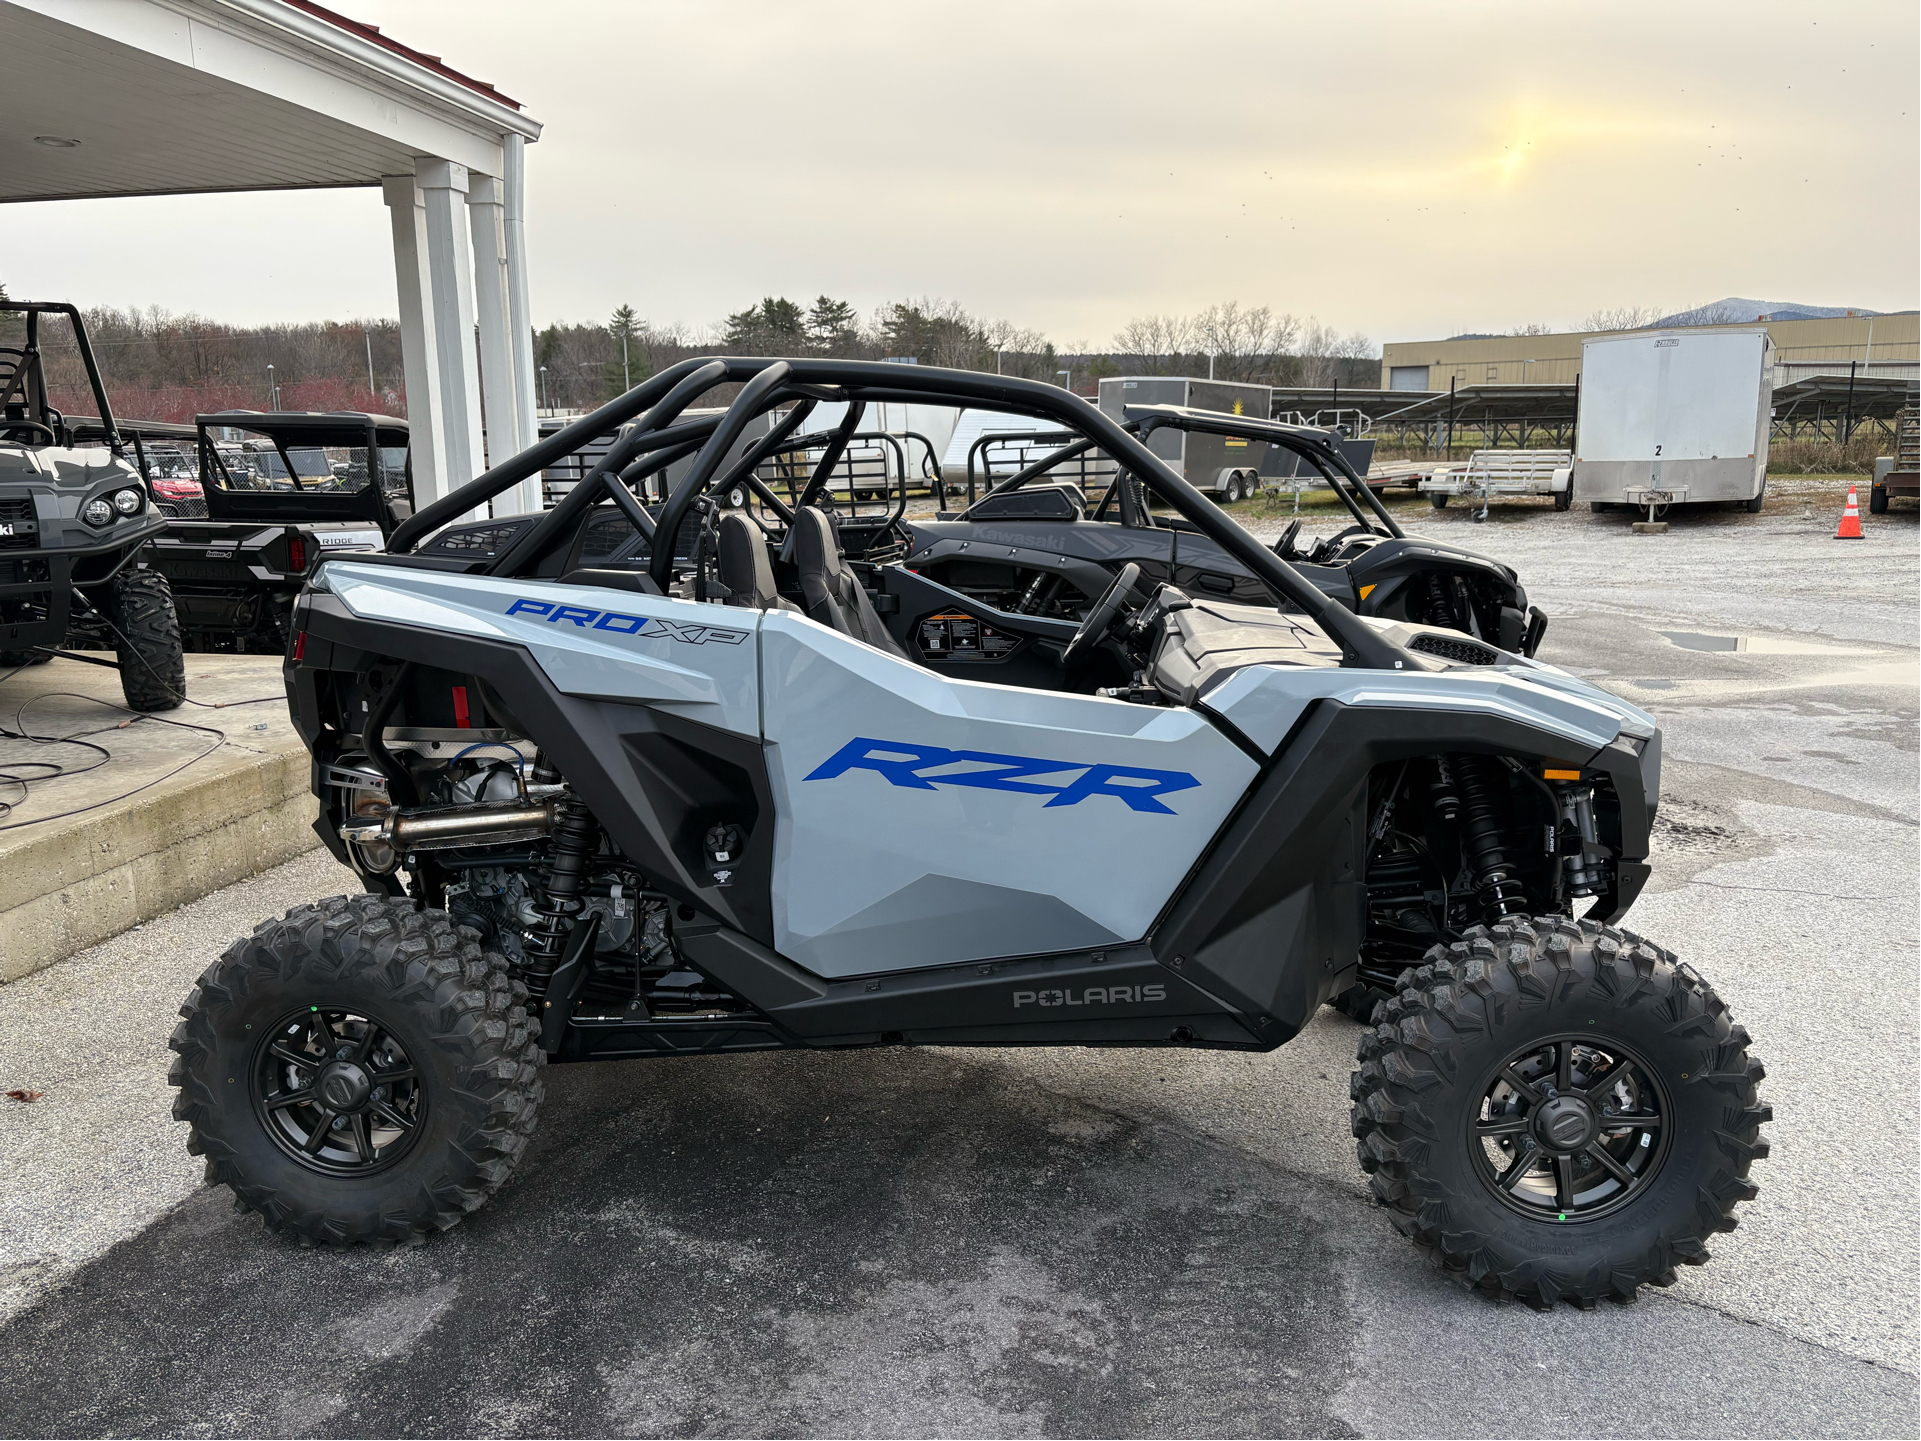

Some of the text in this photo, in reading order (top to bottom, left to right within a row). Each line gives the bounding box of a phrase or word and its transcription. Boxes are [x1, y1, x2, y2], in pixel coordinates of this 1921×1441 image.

[1655, 445, 1662, 456] 2
[971, 526, 1067, 551] Kawasaki
[168, 562, 238, 578] Kawasaki
[505, 599, 750, 646] PRO XP
[802, 736, 1203, 816] RZR
[1012, 984, 1167, 1008] POLARIS
